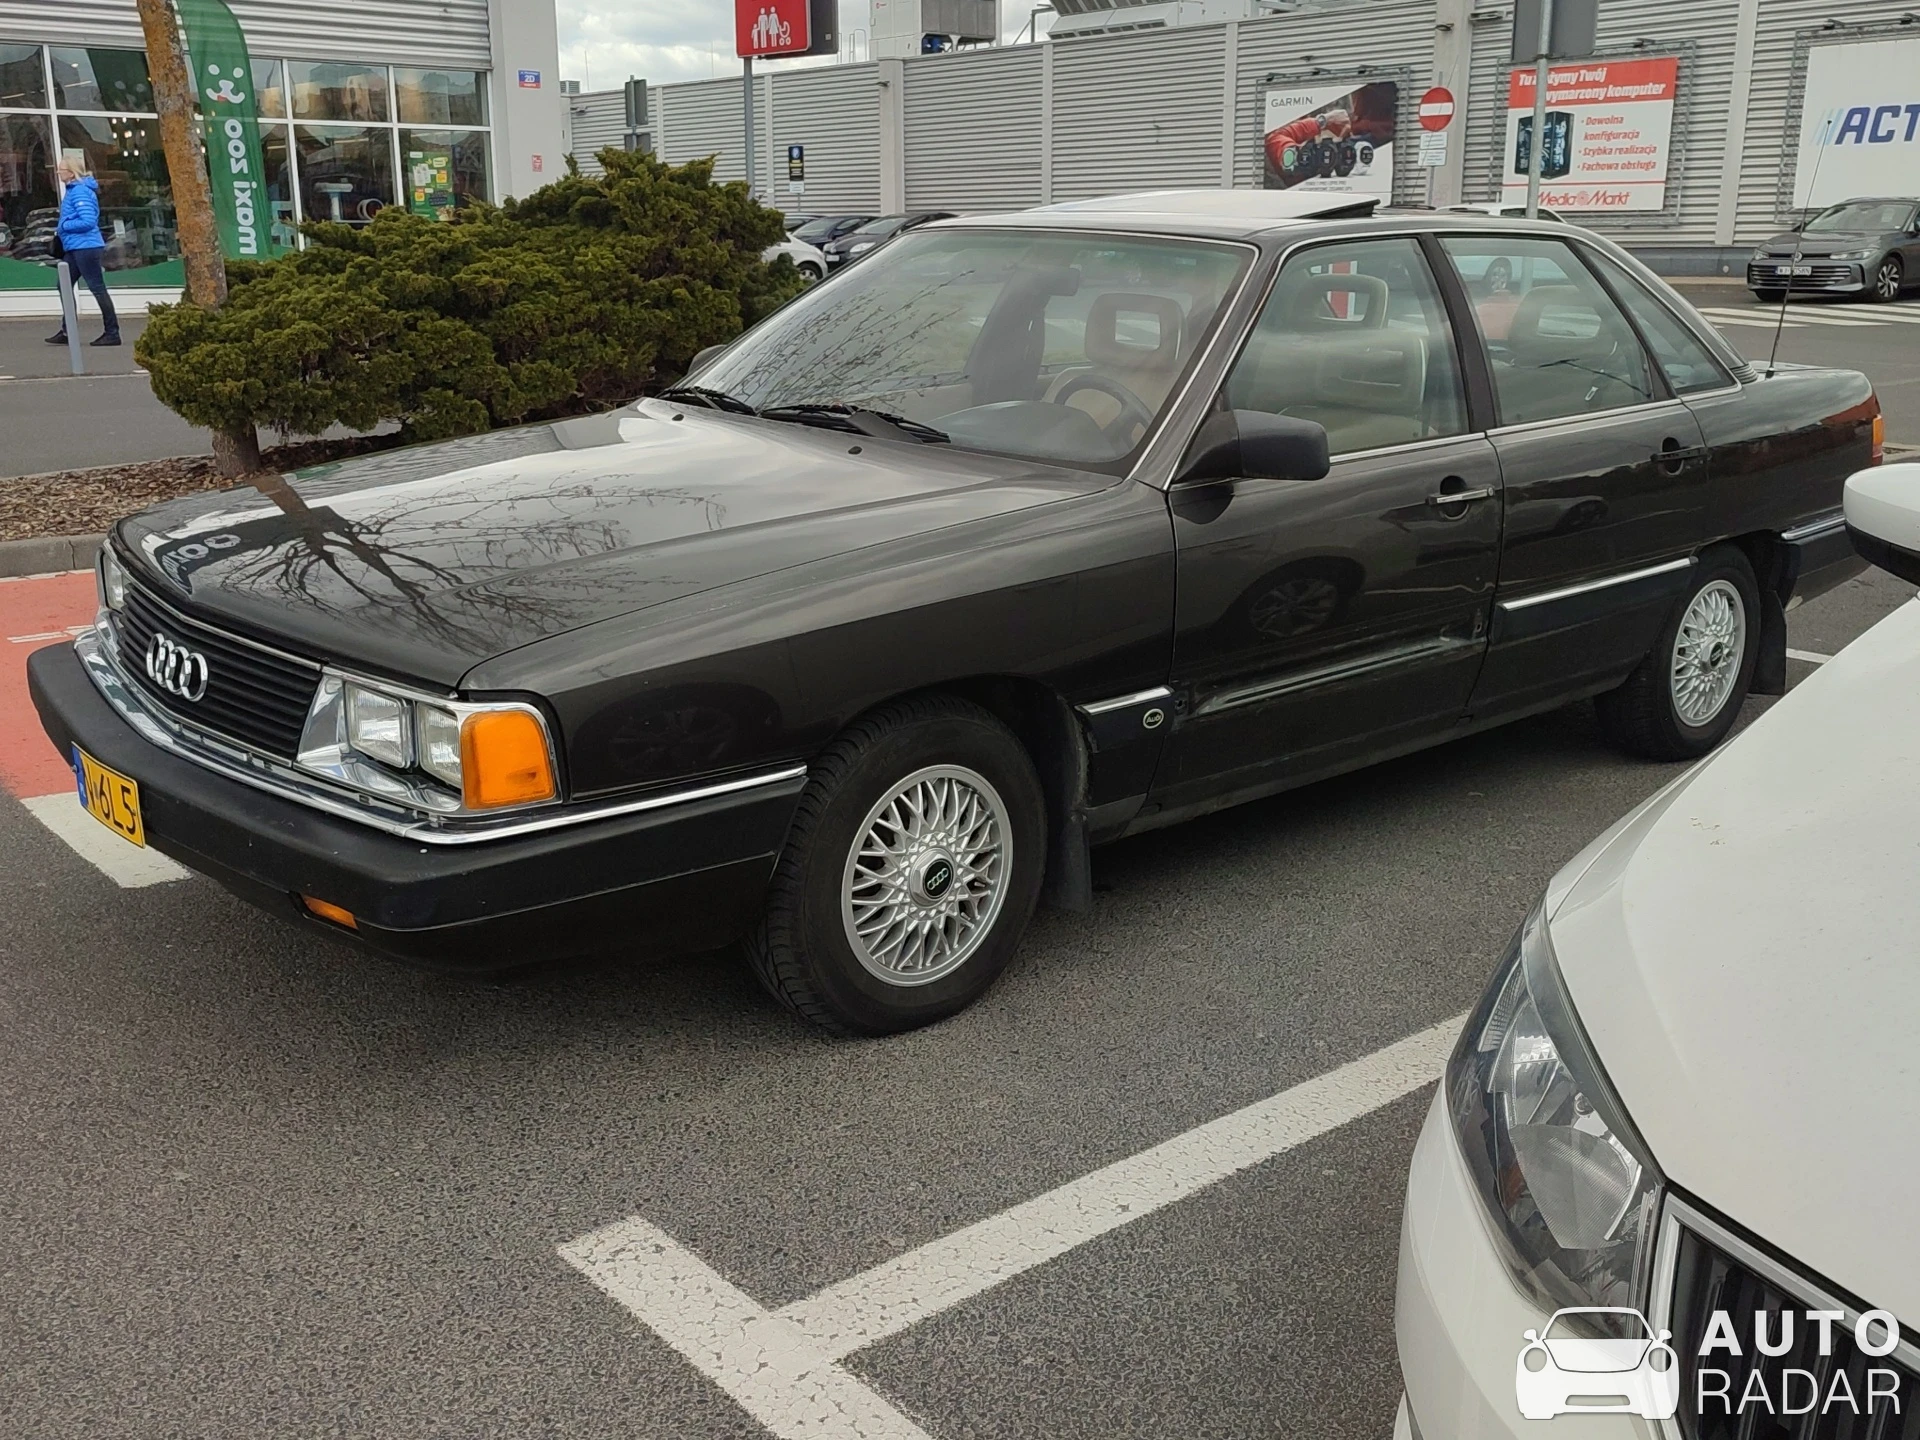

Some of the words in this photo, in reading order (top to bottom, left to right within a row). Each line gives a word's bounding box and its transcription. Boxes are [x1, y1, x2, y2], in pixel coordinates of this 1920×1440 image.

[524, 74, 536, 83] 2D
[1519, 74, 1532, 86] Tu
[1579, 67, 1607, 83] Twój
[1607, 82, 1667, 98] komputer
[1271, 96, 1313, 107] GARMIN
[1585, 115, 1624, 126] Dowolna
[1583, 129, 1641, 142] konfiguracja
[1582, 146, 1614, 158] Szybka
[1614, 144, 1658, 156] realizacja
[1581, 161, 1620, 172] Fachowa
[1620, 160, 1658, 172] obsługa
